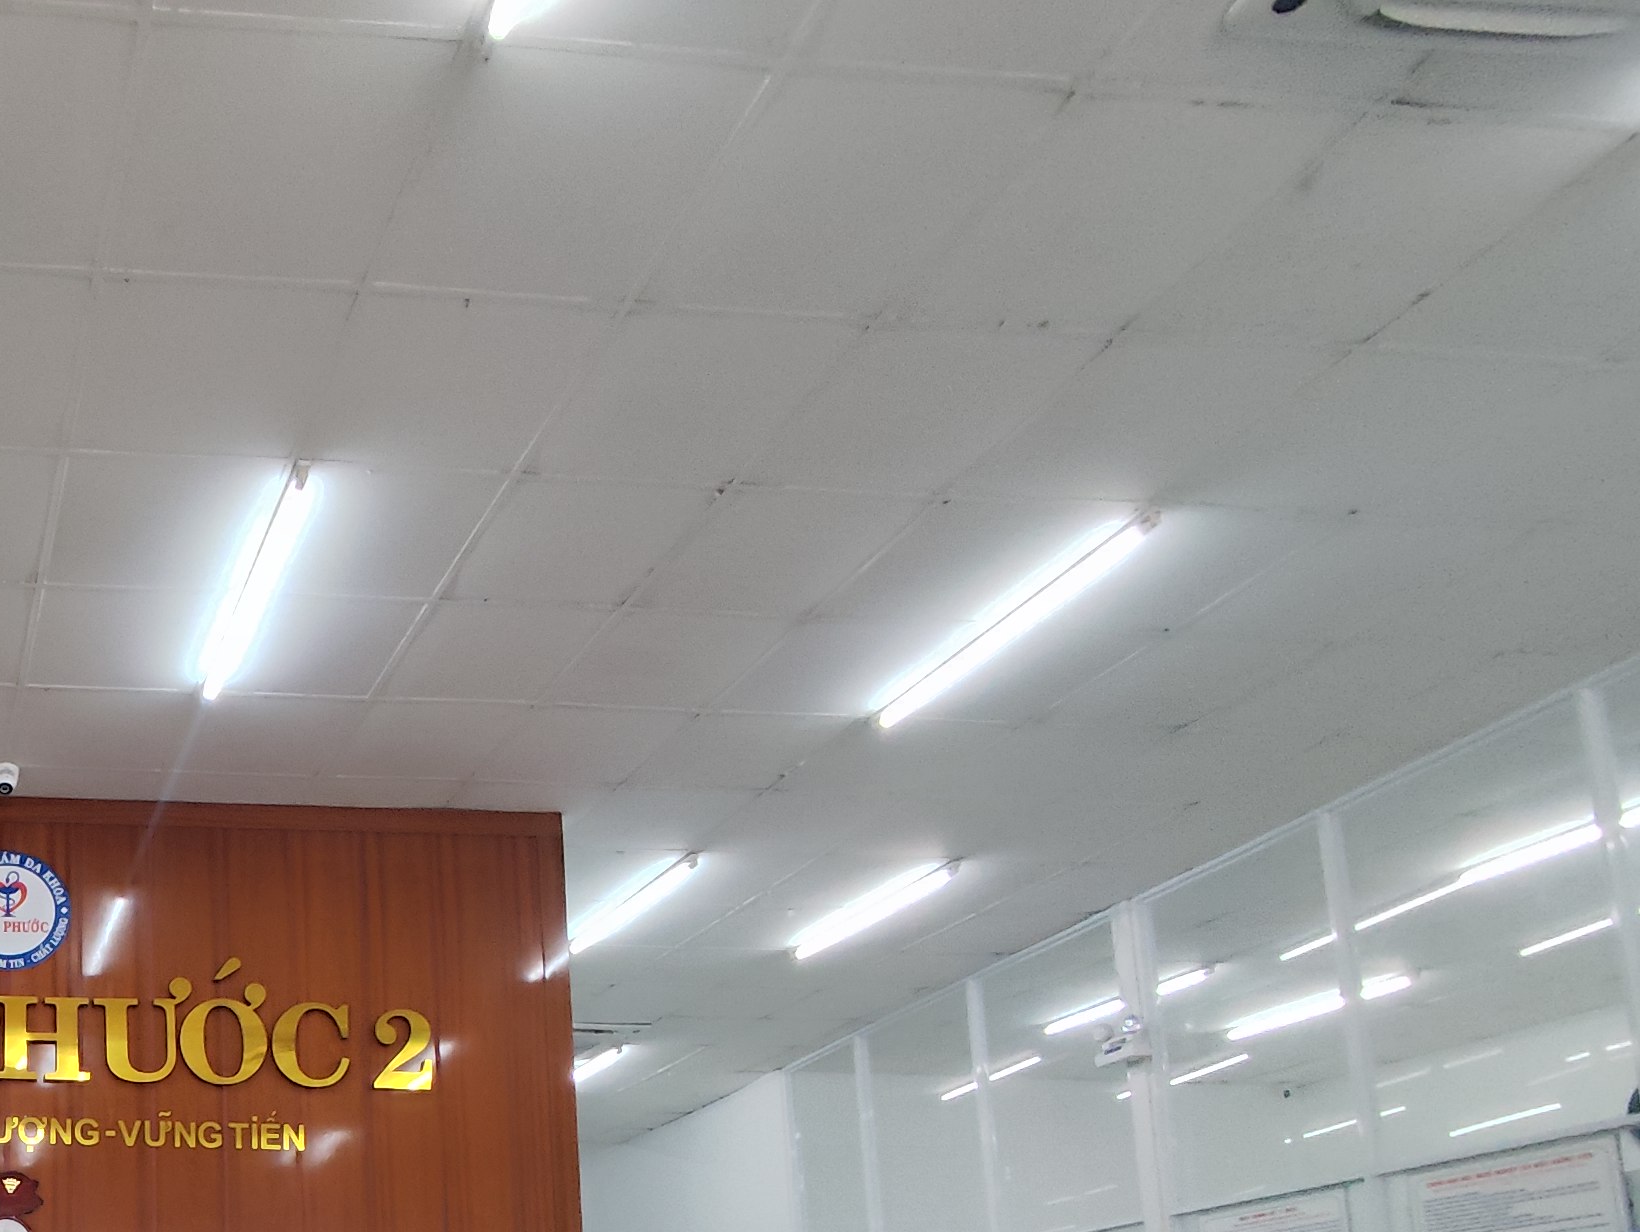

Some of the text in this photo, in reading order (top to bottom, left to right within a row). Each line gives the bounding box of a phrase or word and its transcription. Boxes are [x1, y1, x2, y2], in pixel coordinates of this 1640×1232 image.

[23, 857, 42, 874] ĐA
[42, 869, 67, 905] KHOA
[3, 917, 50, 934] PHƯỚC
[372, 1008, 434, 1091] 2
[118, 1111, 223, 1149] VỮNG
